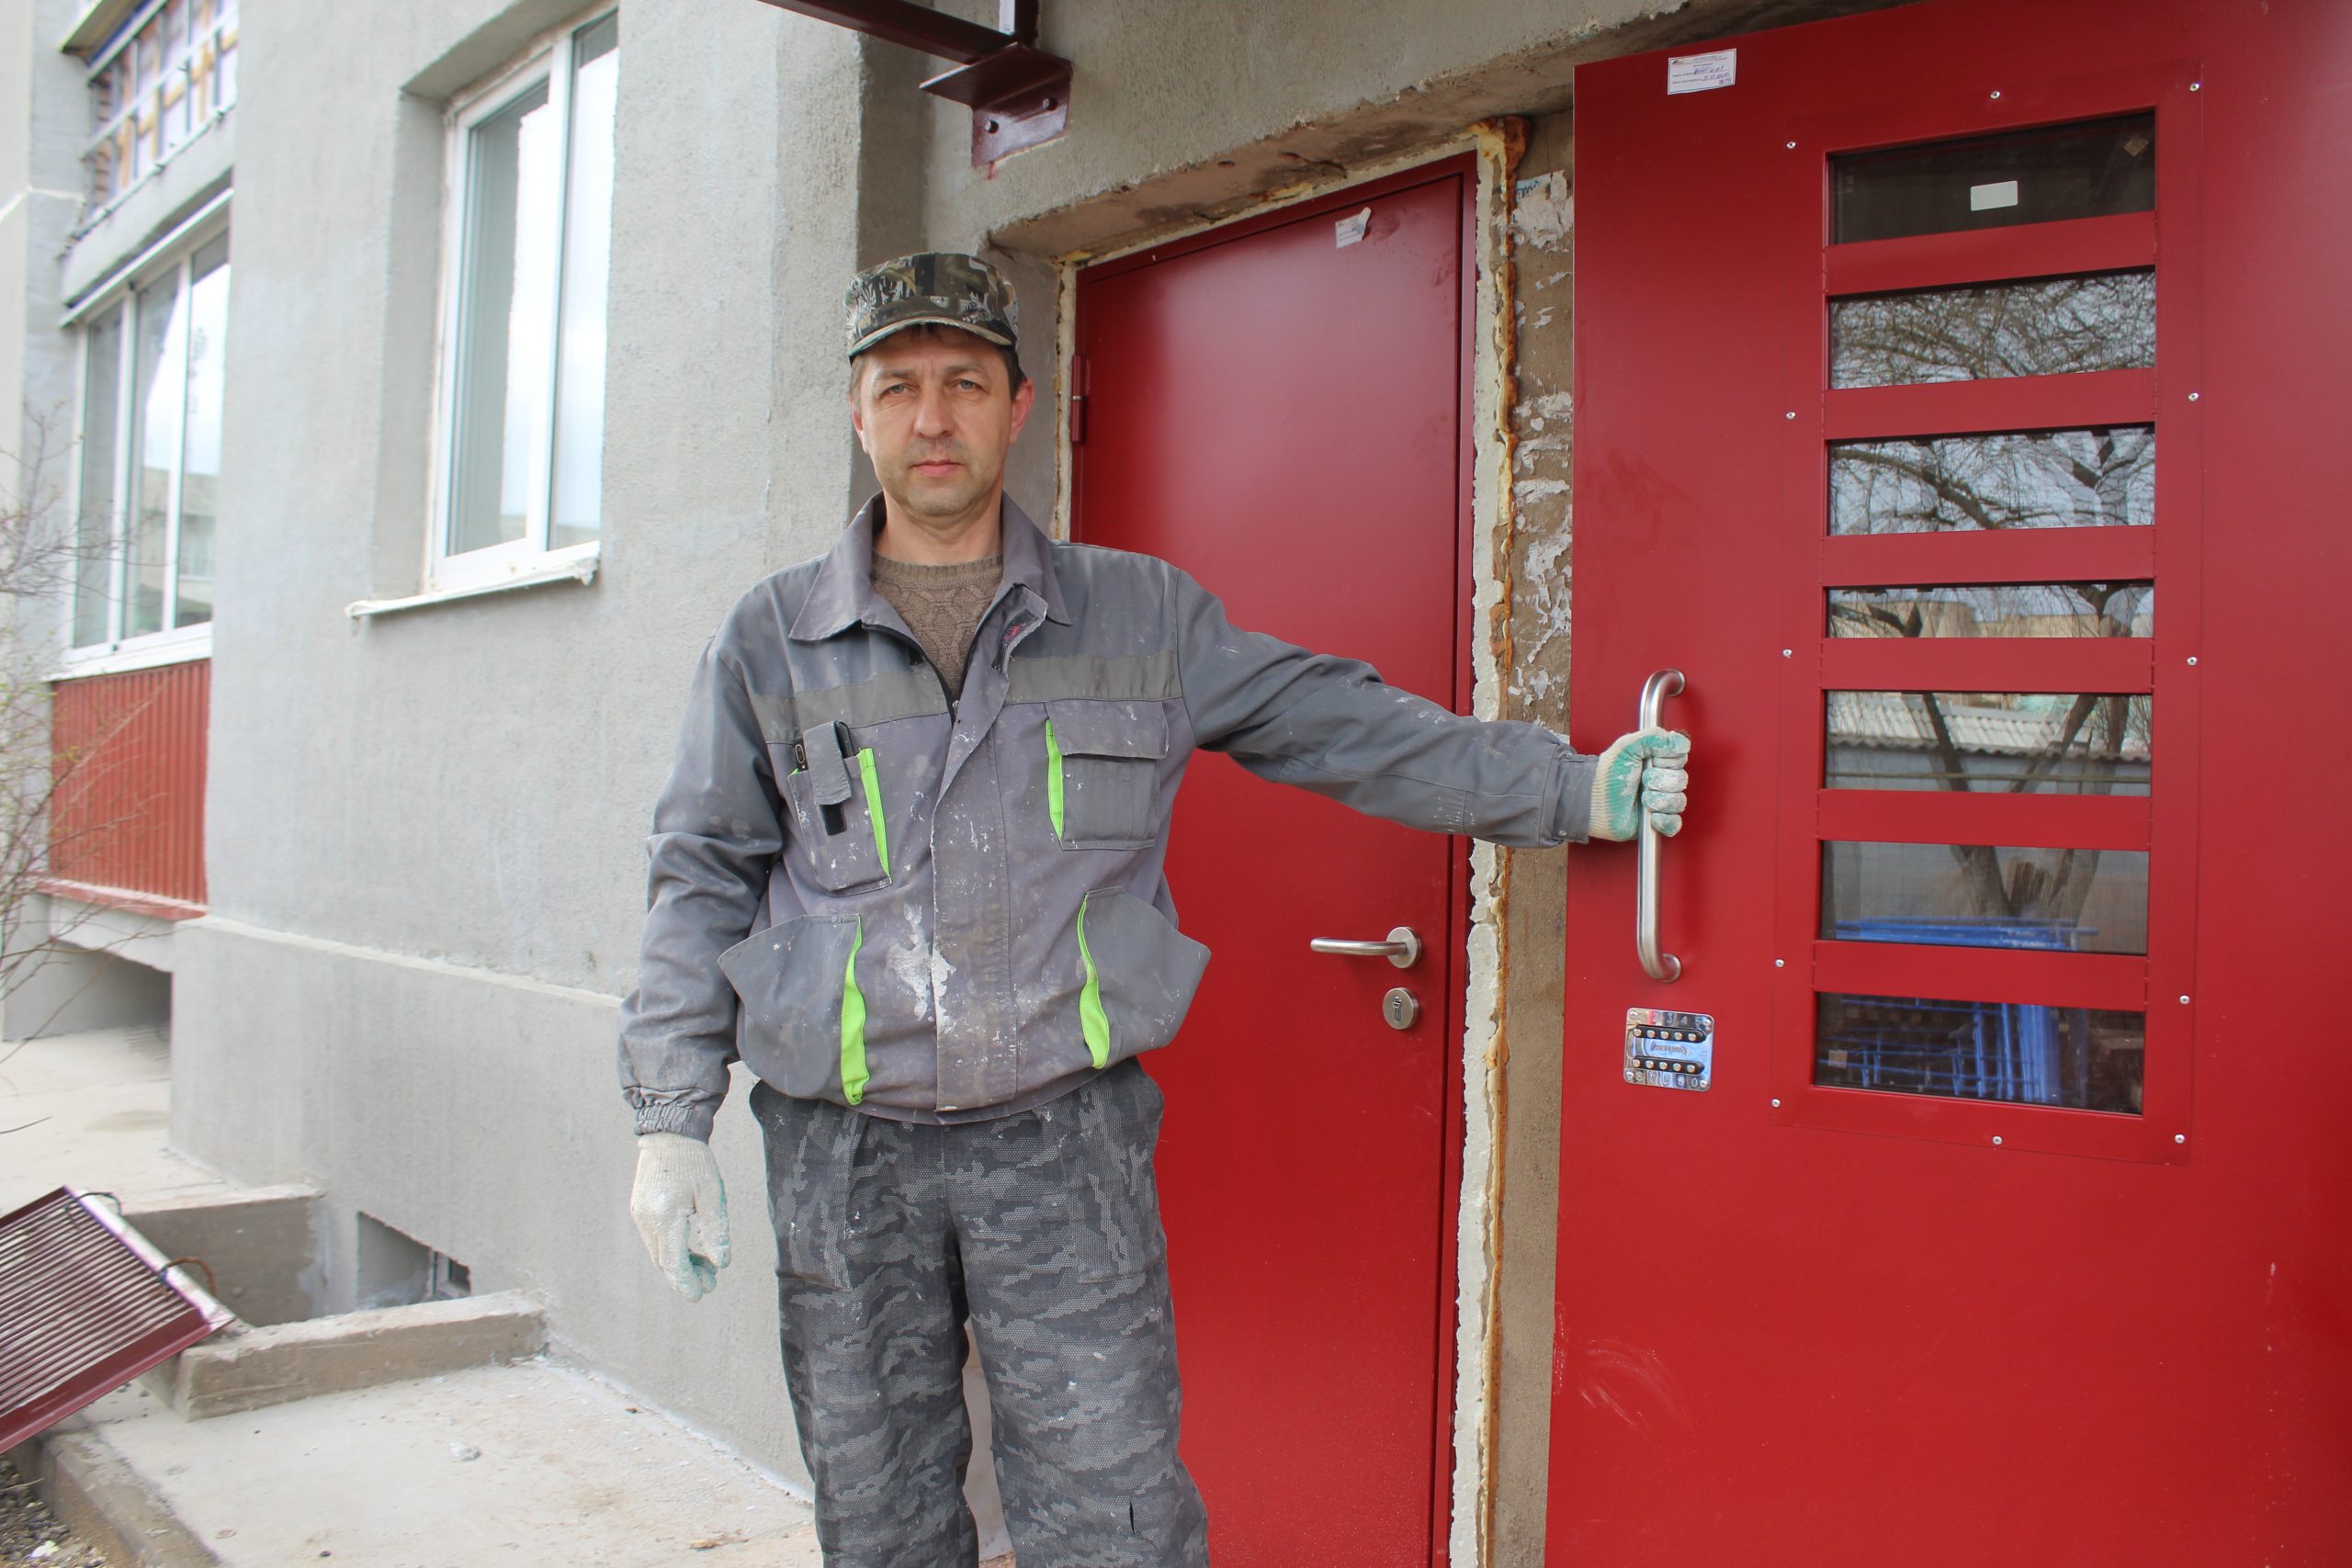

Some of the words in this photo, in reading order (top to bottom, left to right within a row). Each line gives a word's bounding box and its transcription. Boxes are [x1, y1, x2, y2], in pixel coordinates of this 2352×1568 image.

[1667, 1012, 1673, 1023] 3
[1681, 1015, 1687, 1024] 4
[1691, 1077, 1698, 1088] 0
